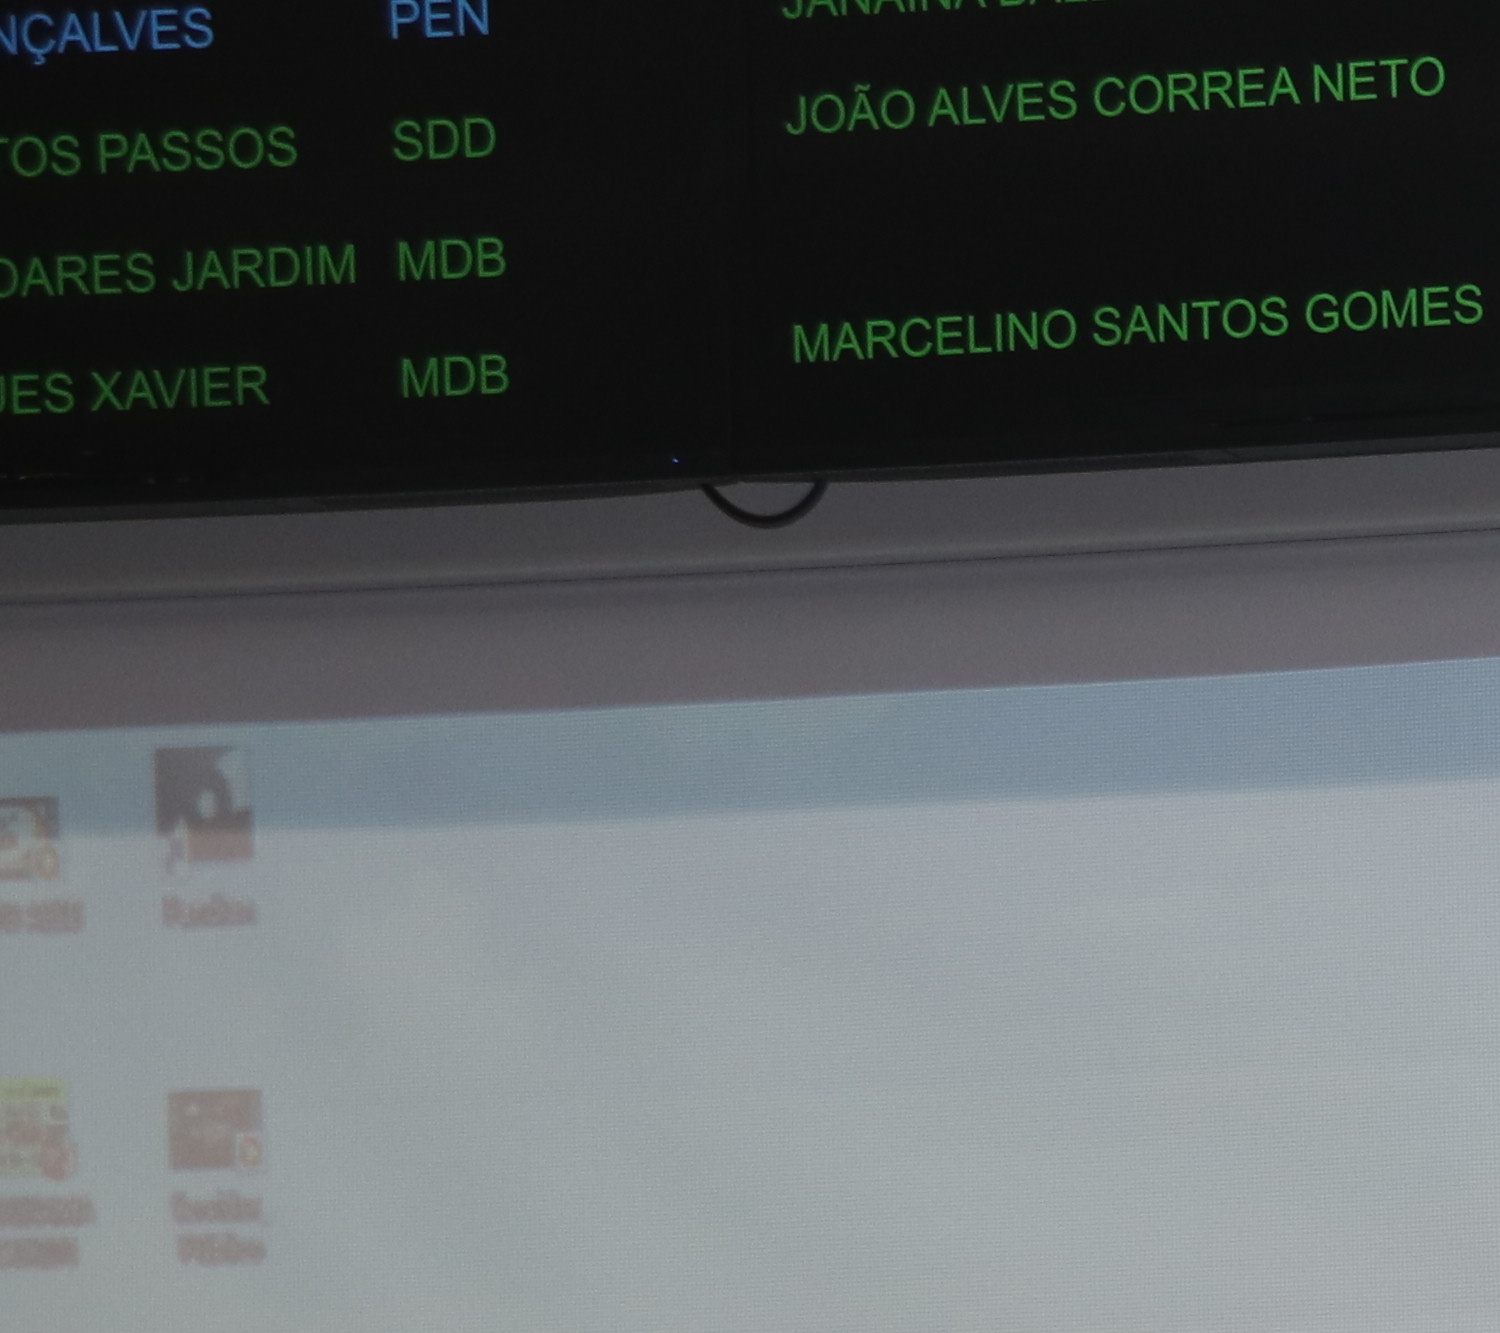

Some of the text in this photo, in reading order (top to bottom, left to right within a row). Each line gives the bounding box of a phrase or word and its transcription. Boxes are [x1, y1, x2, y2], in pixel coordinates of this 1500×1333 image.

[390, 0, 489, 39] PEN
[785, 84, 917, 135] JOÃO
[928, 79, 1078, 126] ALVES
[1093, 66, 1301, 117] CORREA
[1312, 55, 1447, 102] NETO
[98, 125, 298, 172] PASSOS
[393, 117, 497, 162] SDD
[172, 243, 356, 292] JARDIM
[397, 236, 507, 280] MDB
[792, 308, 1077, 363] MARCELINO
[1092, 295, 1290, 346] SANTOS
[1304, 283, 1484, 334] GOMES
[0, 354, 510, 414] ES XAVIER MDB
